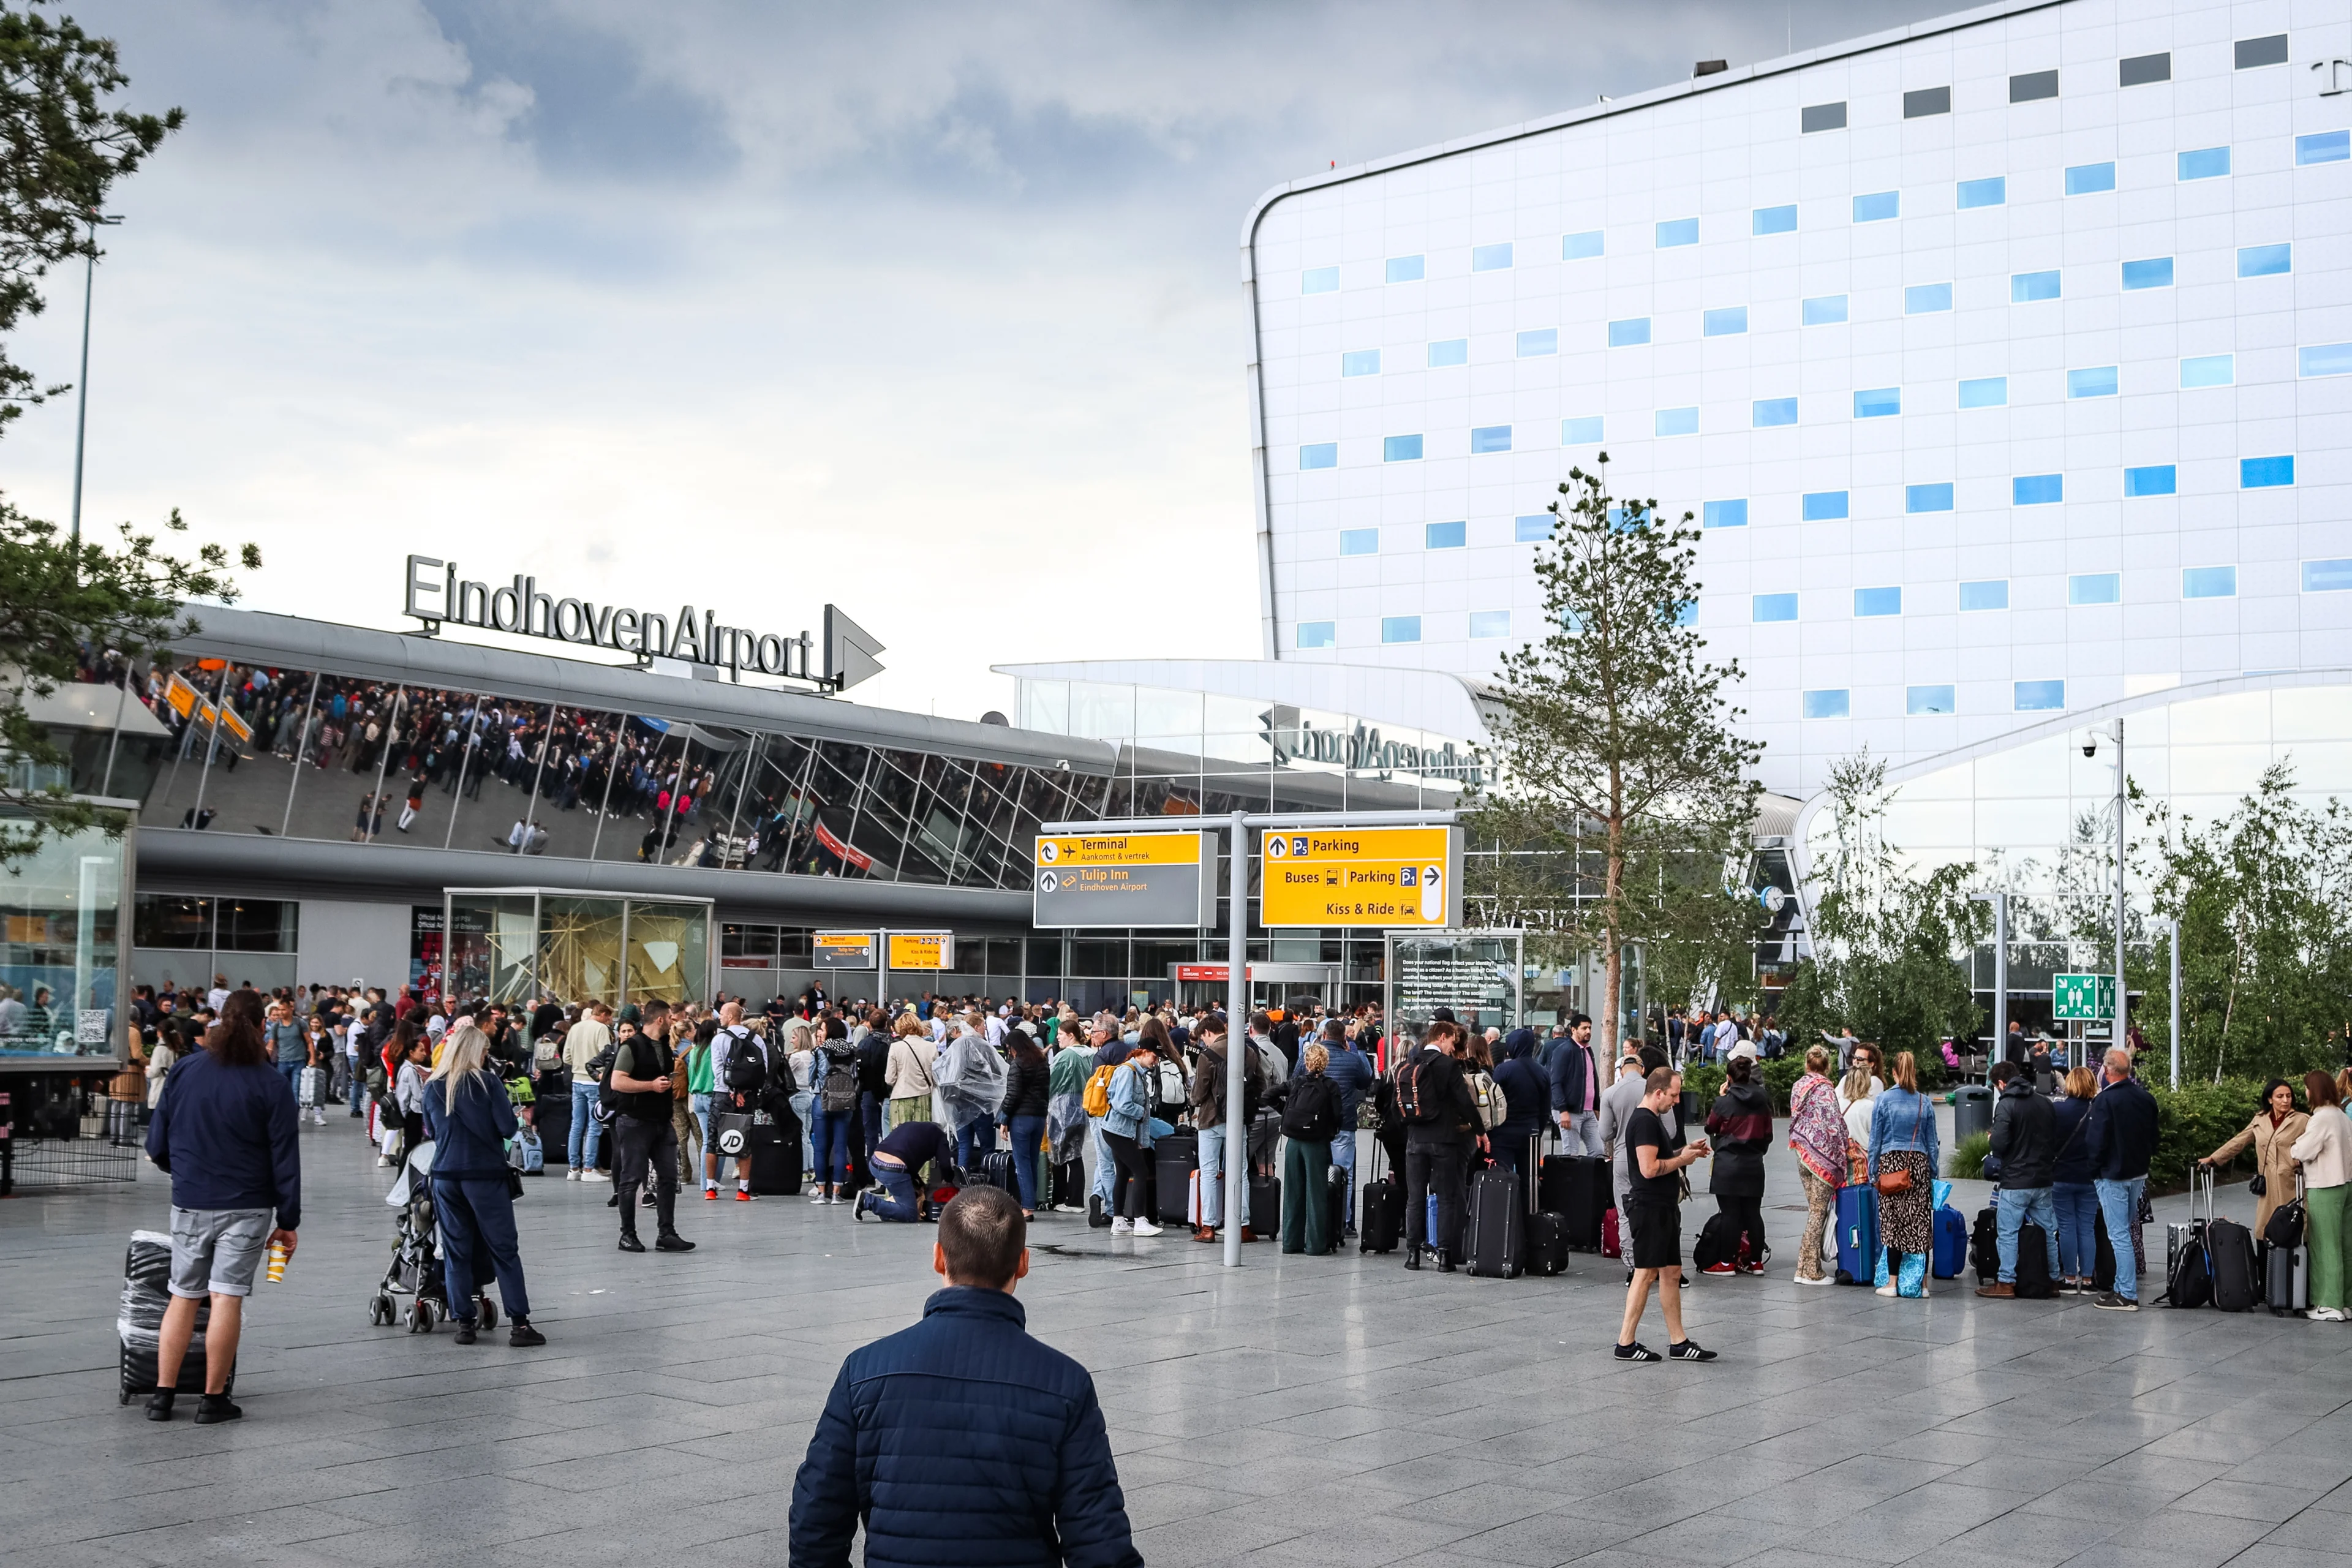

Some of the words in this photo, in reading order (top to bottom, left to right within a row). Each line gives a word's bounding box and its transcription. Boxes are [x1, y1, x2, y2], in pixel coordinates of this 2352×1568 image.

[1080, 837, 1127, 850] Terminal
[1313, 839, 1359, 853] Parking
[1080, 869, 1107, 883] Tulip
[1110, 869, 1128, 880] Inn
[1286, 872, 1319, 883] Buses
[1350, 870, 1395, 885] Parking
[1120, 883, 1147, 892] Airport
[1327, 903, 1350, 914] Kiss
[1354, 903, 1363, 914] &
[1368, 903, 1395, 914] Ride
[723, 1135, 741, 1148] JD
